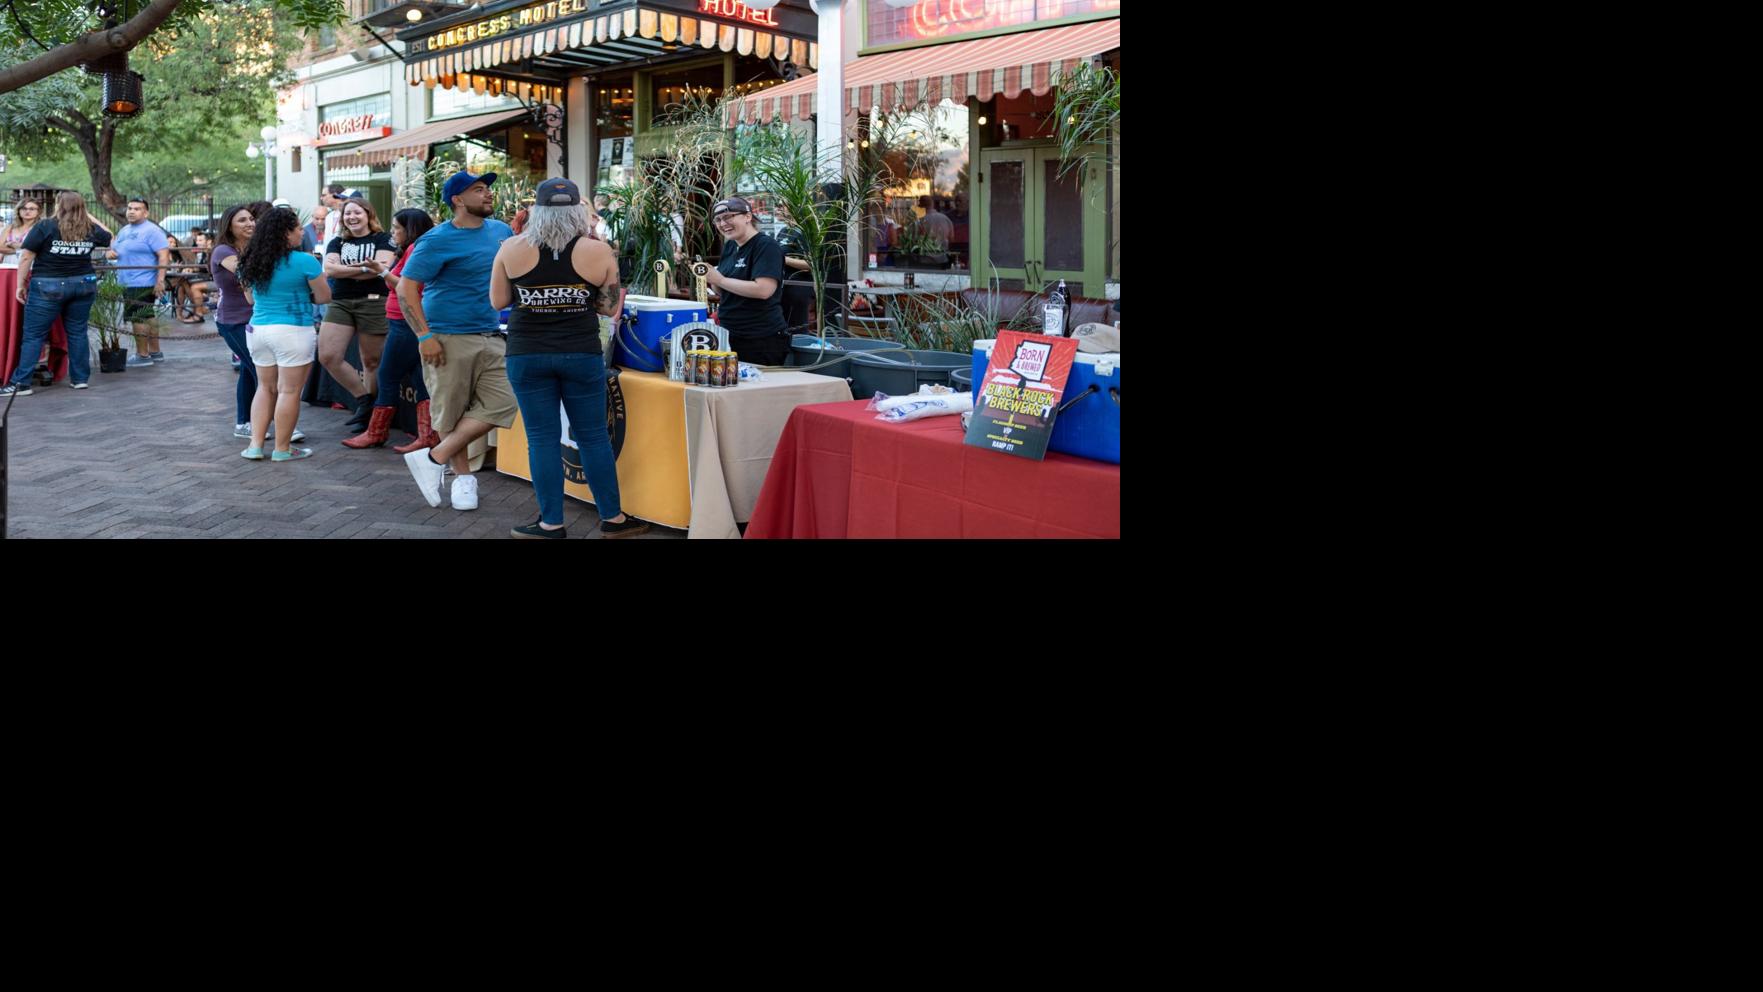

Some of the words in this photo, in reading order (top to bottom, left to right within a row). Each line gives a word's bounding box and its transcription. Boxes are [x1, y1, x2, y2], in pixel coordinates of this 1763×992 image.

[703, 0, 779, 26] HOTEL
[427, 16, 510, 50] CONGRESS
[655, 262, 663, 271] B
[697, 265, 706, 274] B
[517, 287, 591, 305] BARRIO
[530, 297, 572, 306] BREWING
[690, 334, 712, 351] B
[1020, 348, 1045, 363] BORN
[1021, 361, 1042, 372] BREWED
[608, 376, 625, 419] NATIVE
[987, 384, 1020, 399] BLACK
[1022, 390, 1054, 406] ROCK
[990, 397, 1042, 416] BREWERS
